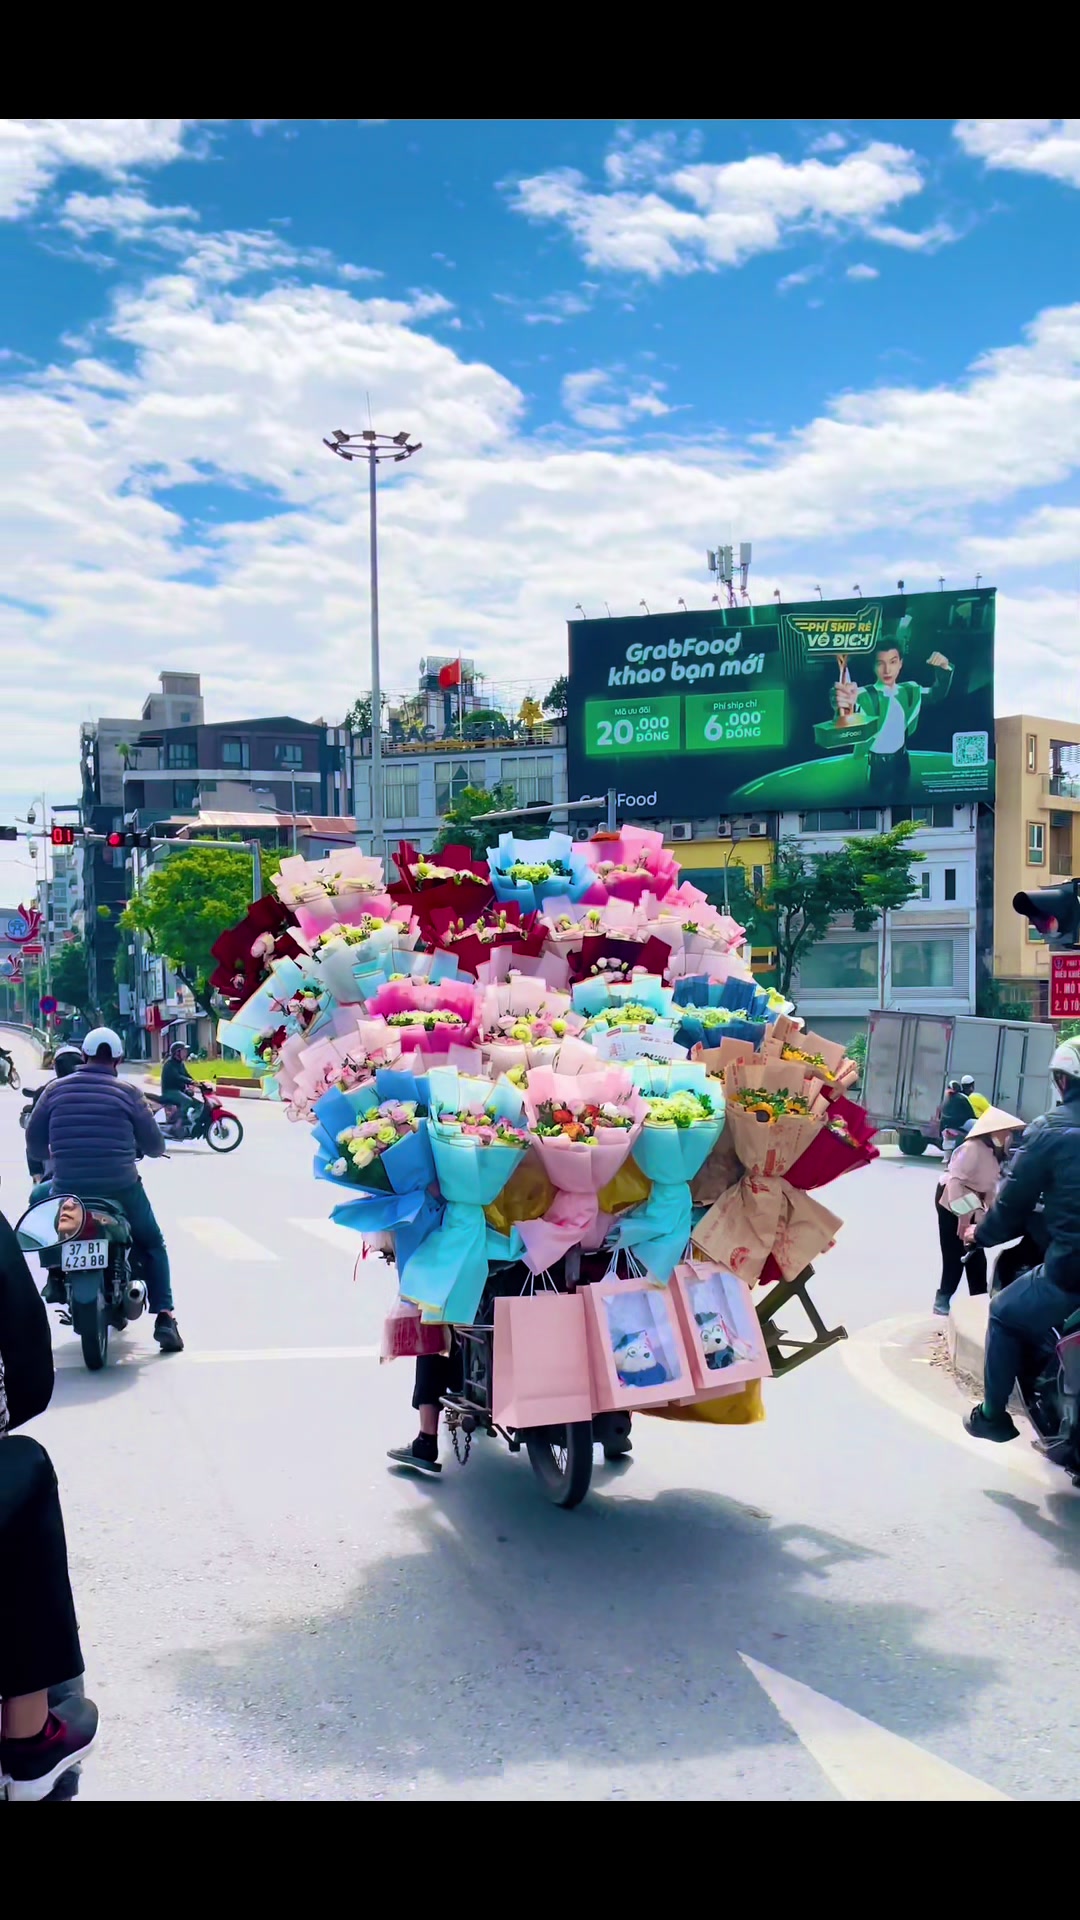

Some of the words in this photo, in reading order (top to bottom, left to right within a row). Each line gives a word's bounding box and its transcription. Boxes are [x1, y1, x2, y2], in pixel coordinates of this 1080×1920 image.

[808, 620, 829, 632] PHÍ
[830, 622, 857, 632] SHIP
[626, 632, 741, 663] GrabFood
[808, 632, 831, 647] VÔ
[832, 633, 870, 649] ĐỊCH
[608, 665, 666, 686] khao
[671, 661, 715, 684] bạn
[719, 653, 765, 676] mới
[614, 708, 627, 716] Mã
[638, 705, 651, 714] đãi
[713, 702, 726, 711] Phí
[727, 701, 744, 711] ship
[745, 699, 757, 708] chỉ
[636, 727, 670, 742] ĐỒNG
[726, 725, 761, 739] ĐỒNG
[53, 827, 71, 843] 01
[1055, 983, 1062, 994] 1.
[1064, 981, 1076, 994] MÔ
[1055, 999, 1061, 1011] 2.
[69, 1243, 82, 1256] 37
[88, 1242, 100, 1254] B1
